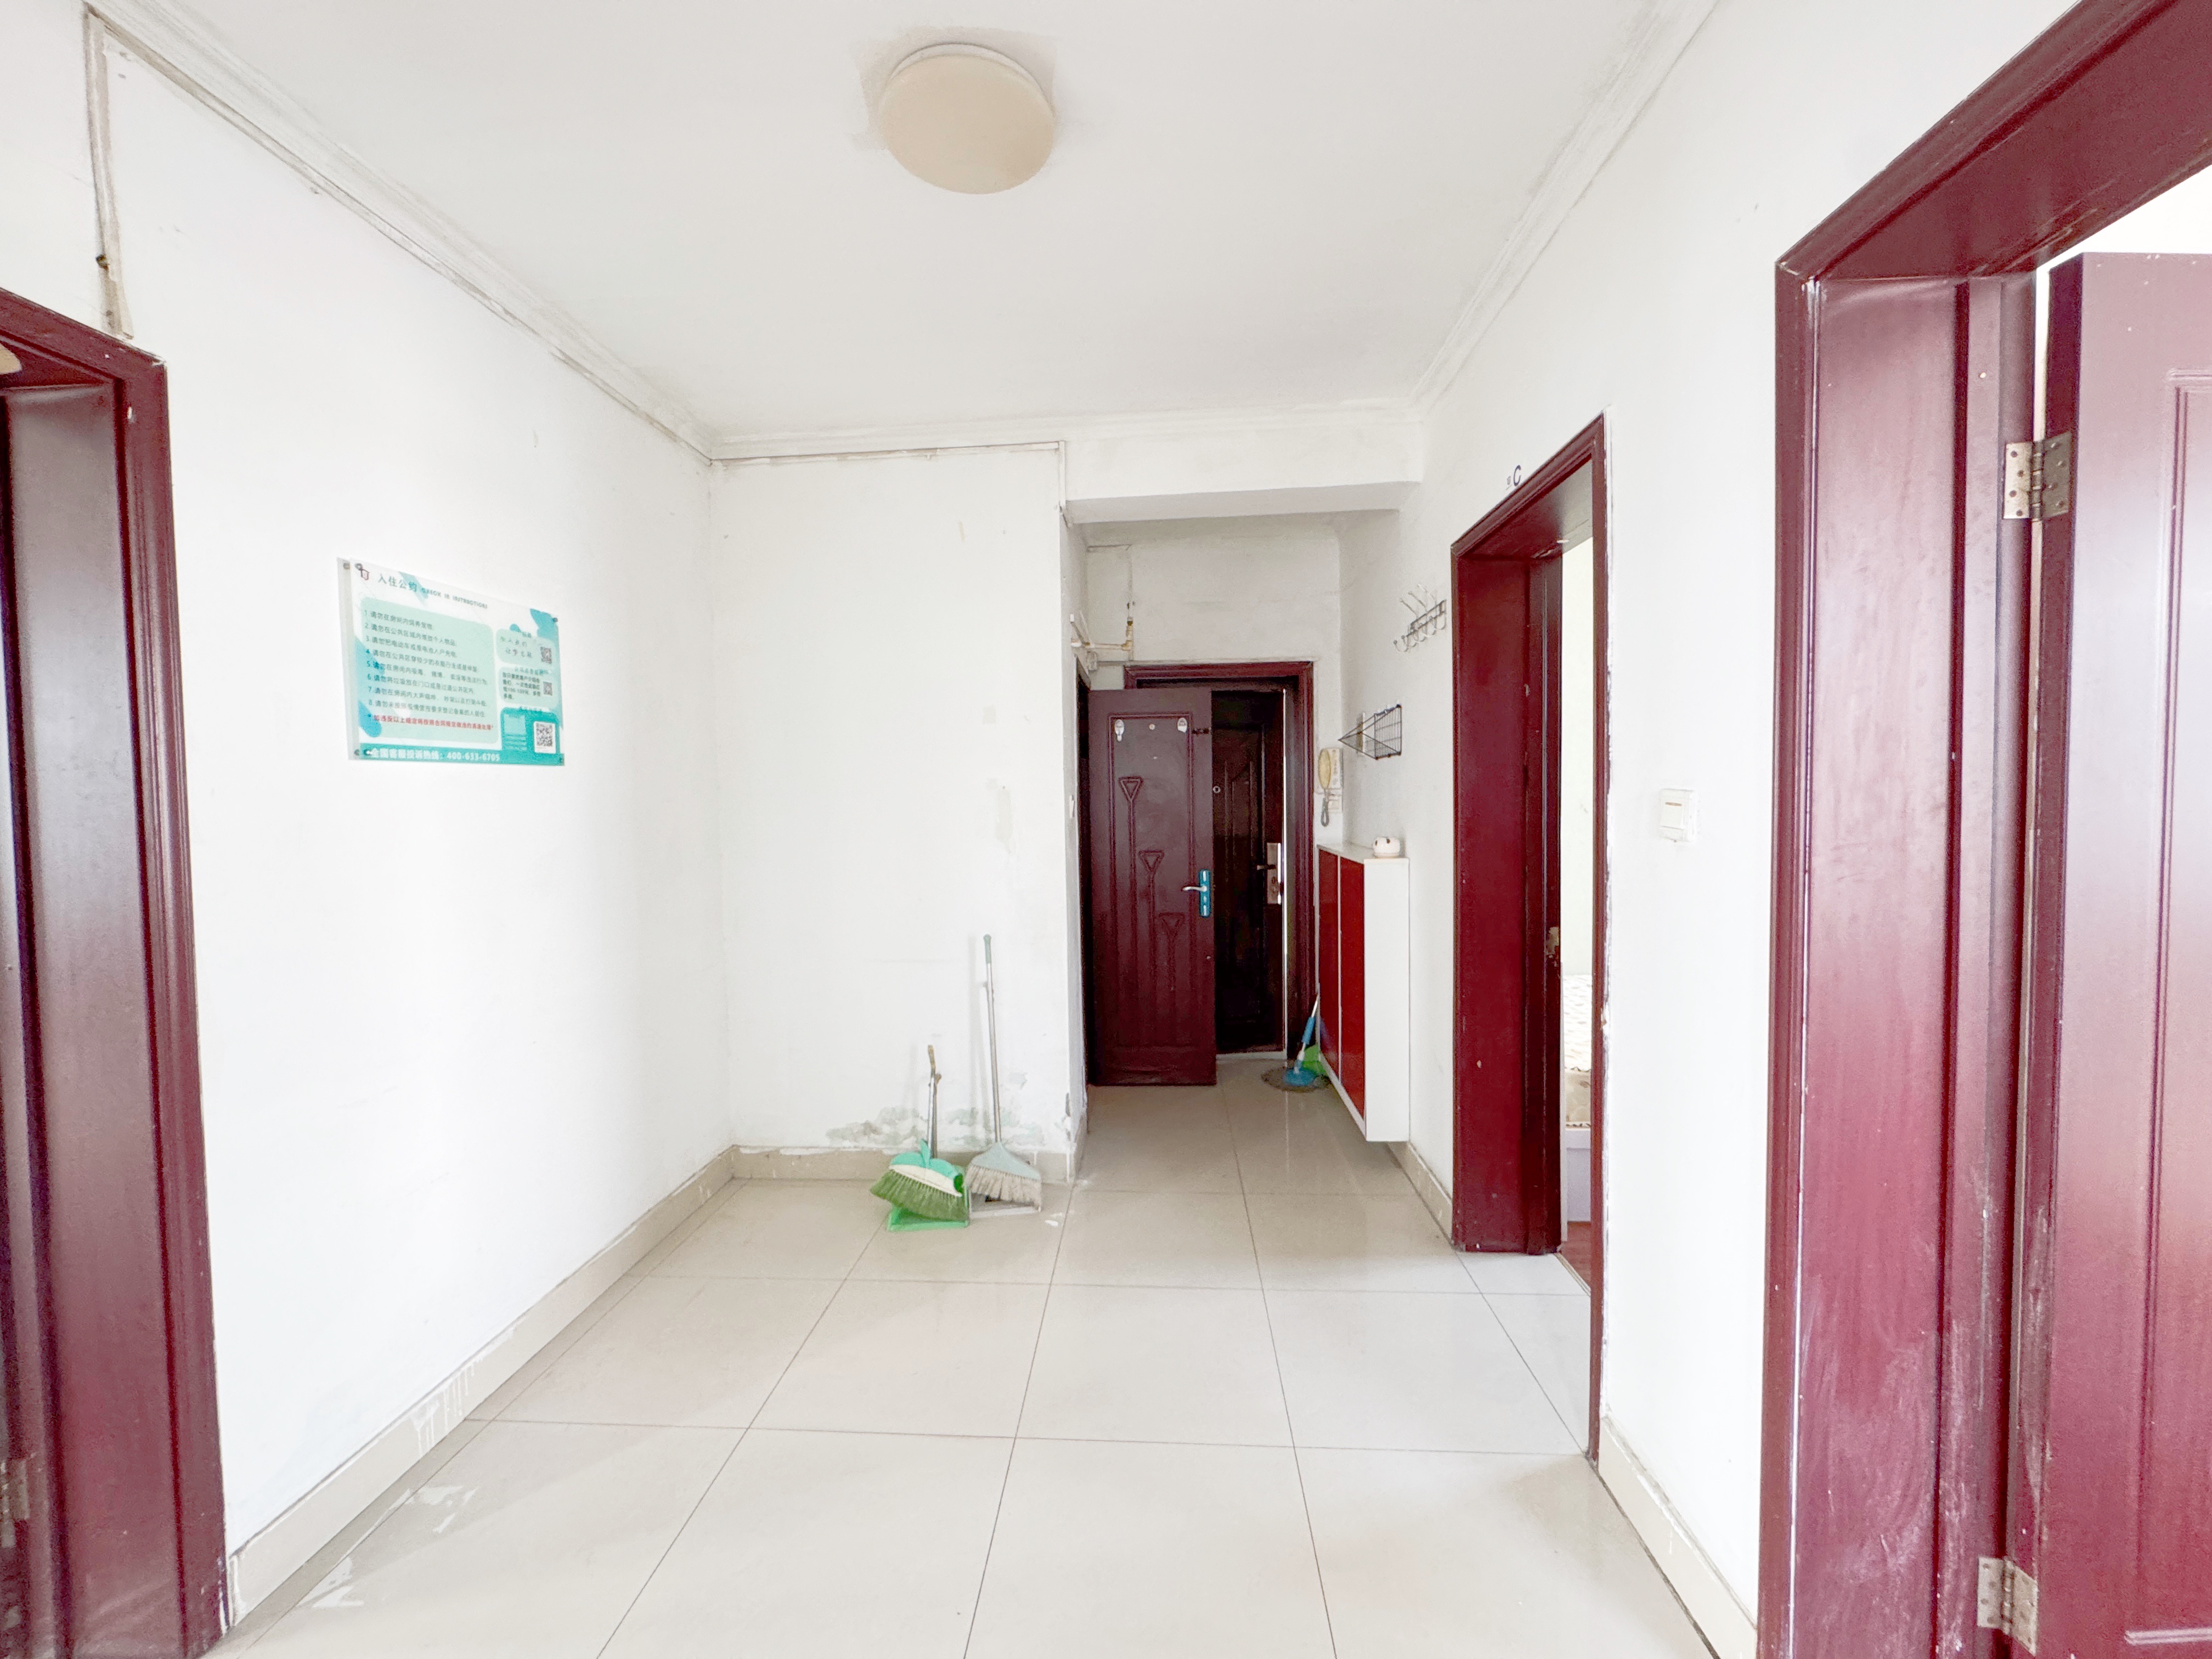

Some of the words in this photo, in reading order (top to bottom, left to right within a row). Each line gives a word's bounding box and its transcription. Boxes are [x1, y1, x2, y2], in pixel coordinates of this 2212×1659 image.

[1513, 465, 1521, 487] C
[378, 573, 417, 592] 入住公约
